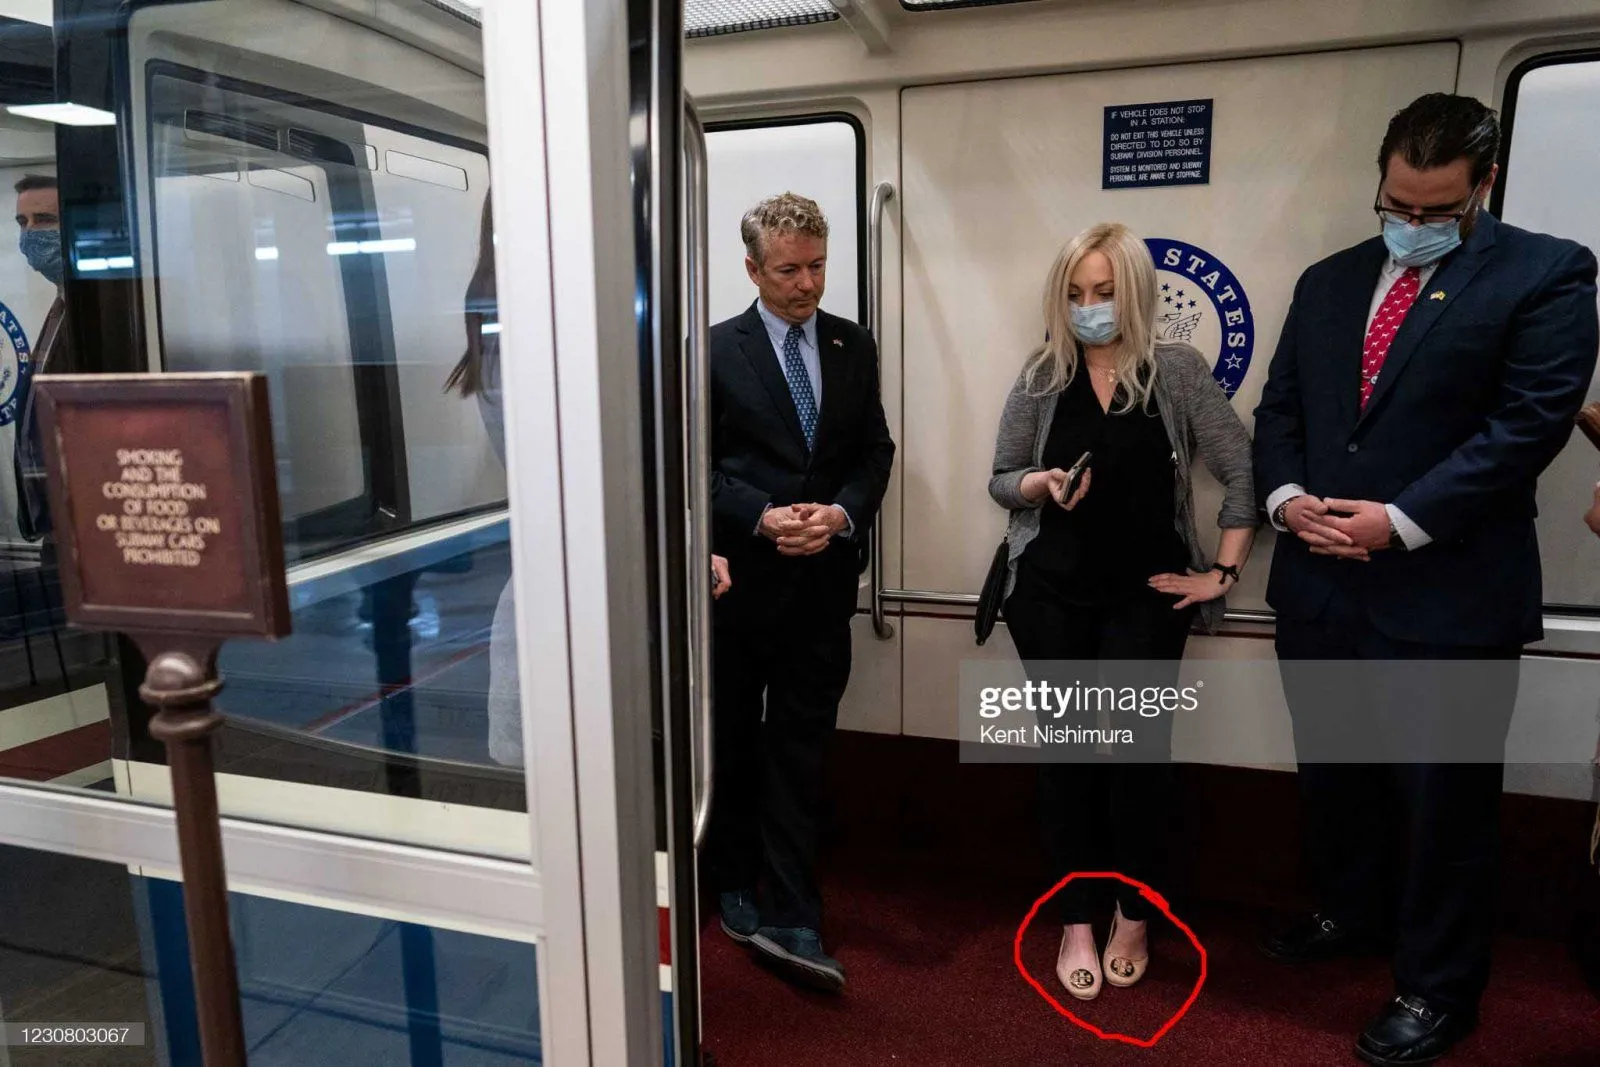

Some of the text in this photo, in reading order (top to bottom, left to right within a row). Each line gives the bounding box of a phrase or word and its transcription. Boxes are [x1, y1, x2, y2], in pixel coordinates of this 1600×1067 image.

[1111, 111, 1117, 119] IF
[1120, 110, 1147, 118] VEHICLE
[1150, 108, 1168, 116] DOES
[1188, 105, 1205, 113] STOP
[1161, 129, 1182, 137] VEHICLE
[1111, 142, 1146, 150] DIRECTED
[1111, 152, 1135, 160] SUBWAY
[1137, 150, 1163, 158] DIVISION
[1110, 165, 1129, 173] SYSTEM
[1132, 164, 1136, 172] IS
[1138, 163, 1167, 171] MONITORED
[1110, 174, 1136, 182] PERSONNEL
[1150, 172, 1166, 180] AWARE
[1163, 247, 1247, 348] STATES
[116, 448, 183, 466] SMOKING
[120, 466, 181, 482] AND THE
[102, 482, 206, 500] CONSUMPTION
[123, 499, 189, 516] OF FOOD
[96, 514, 221, 534] OR BEVERAGES ON
[115, 531, 205, 550] SUBWAY CARS
[123, 547, 201, 567] PROHIBITED
